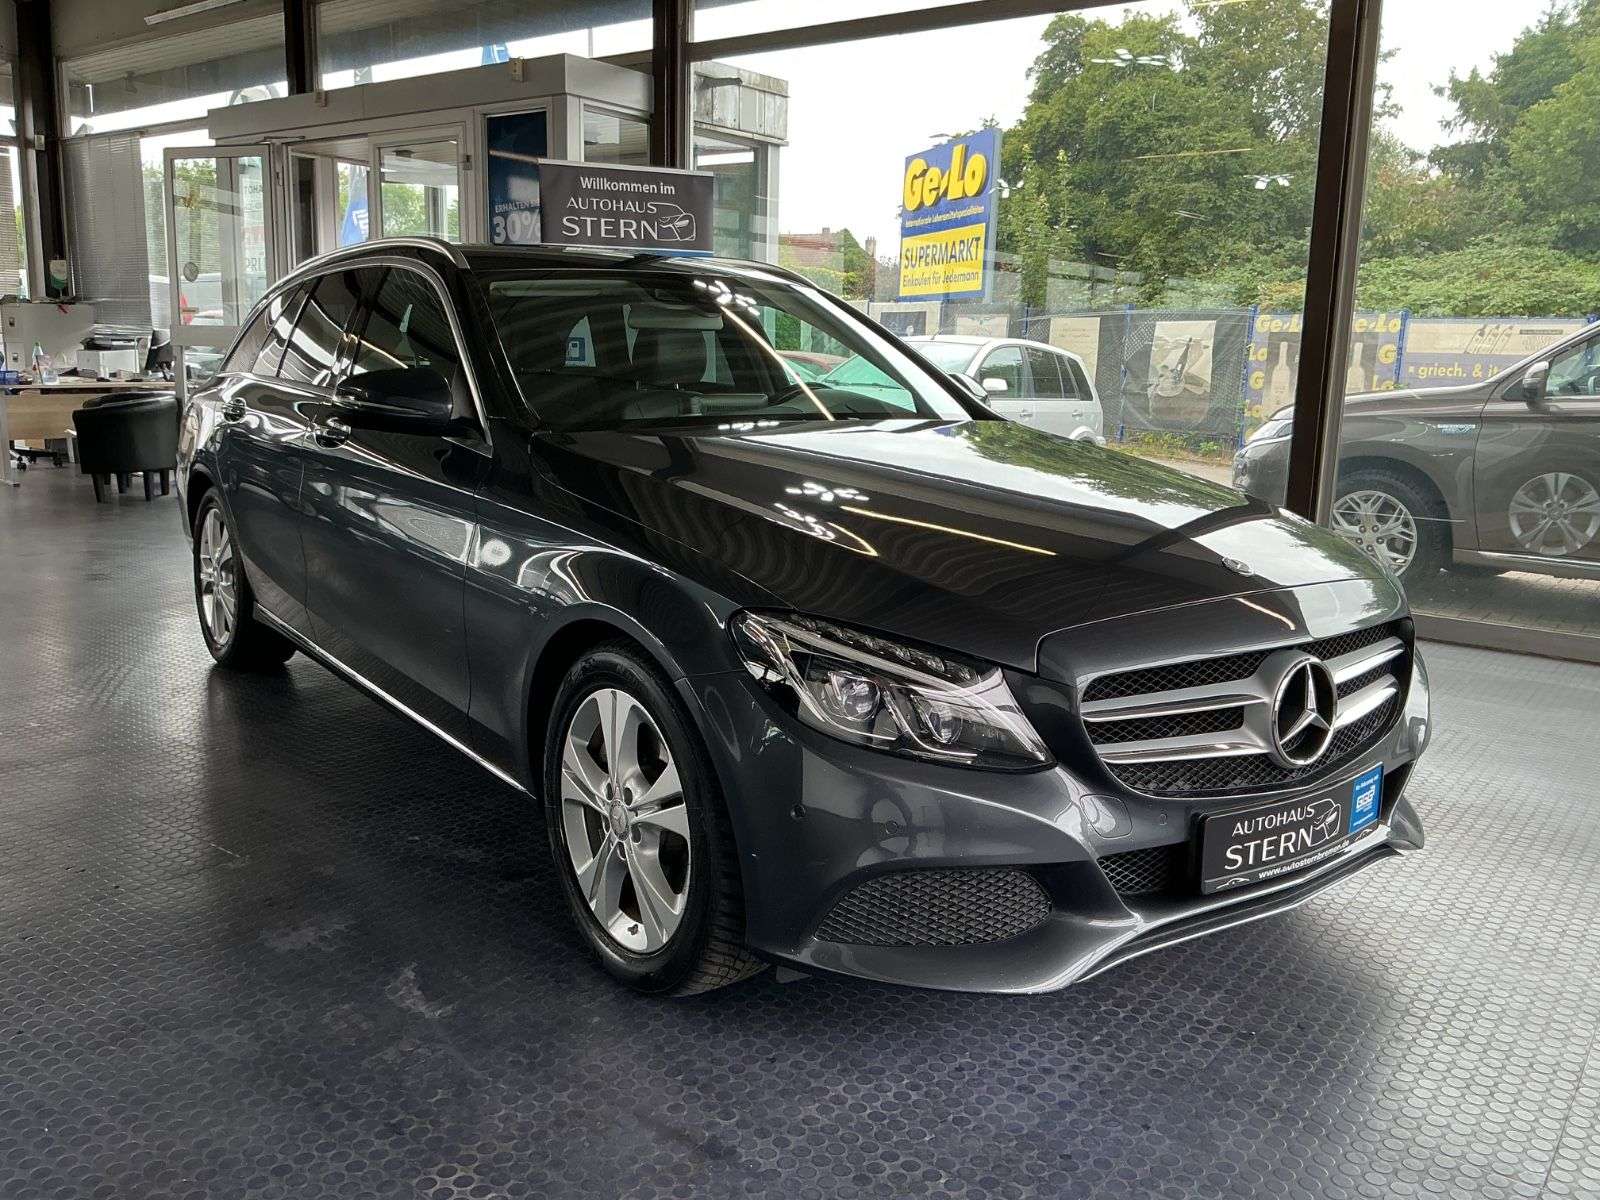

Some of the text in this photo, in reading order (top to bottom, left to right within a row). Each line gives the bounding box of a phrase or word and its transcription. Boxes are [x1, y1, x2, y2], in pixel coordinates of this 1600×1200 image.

[580, 176, 675, 195] Willkommen im
[495, 201, 529, 213] ERHALTEN
[566, 197, 657, 213] AUTOHAUS
[493, 209, 540, 244] 30%
[562, 216, 658, 240] STERN
[904, 237, 980, 270] SUPERMARKT
[903, 269, 979, 287] Einkaufen für Jedermann
[1418, 363, 1467, 379] griech.
[1472, 363, 1483, 378] &
[1231, 805, 1315, 837] AUTOHAUS
[1224, 826, 1313, 870] STERN
